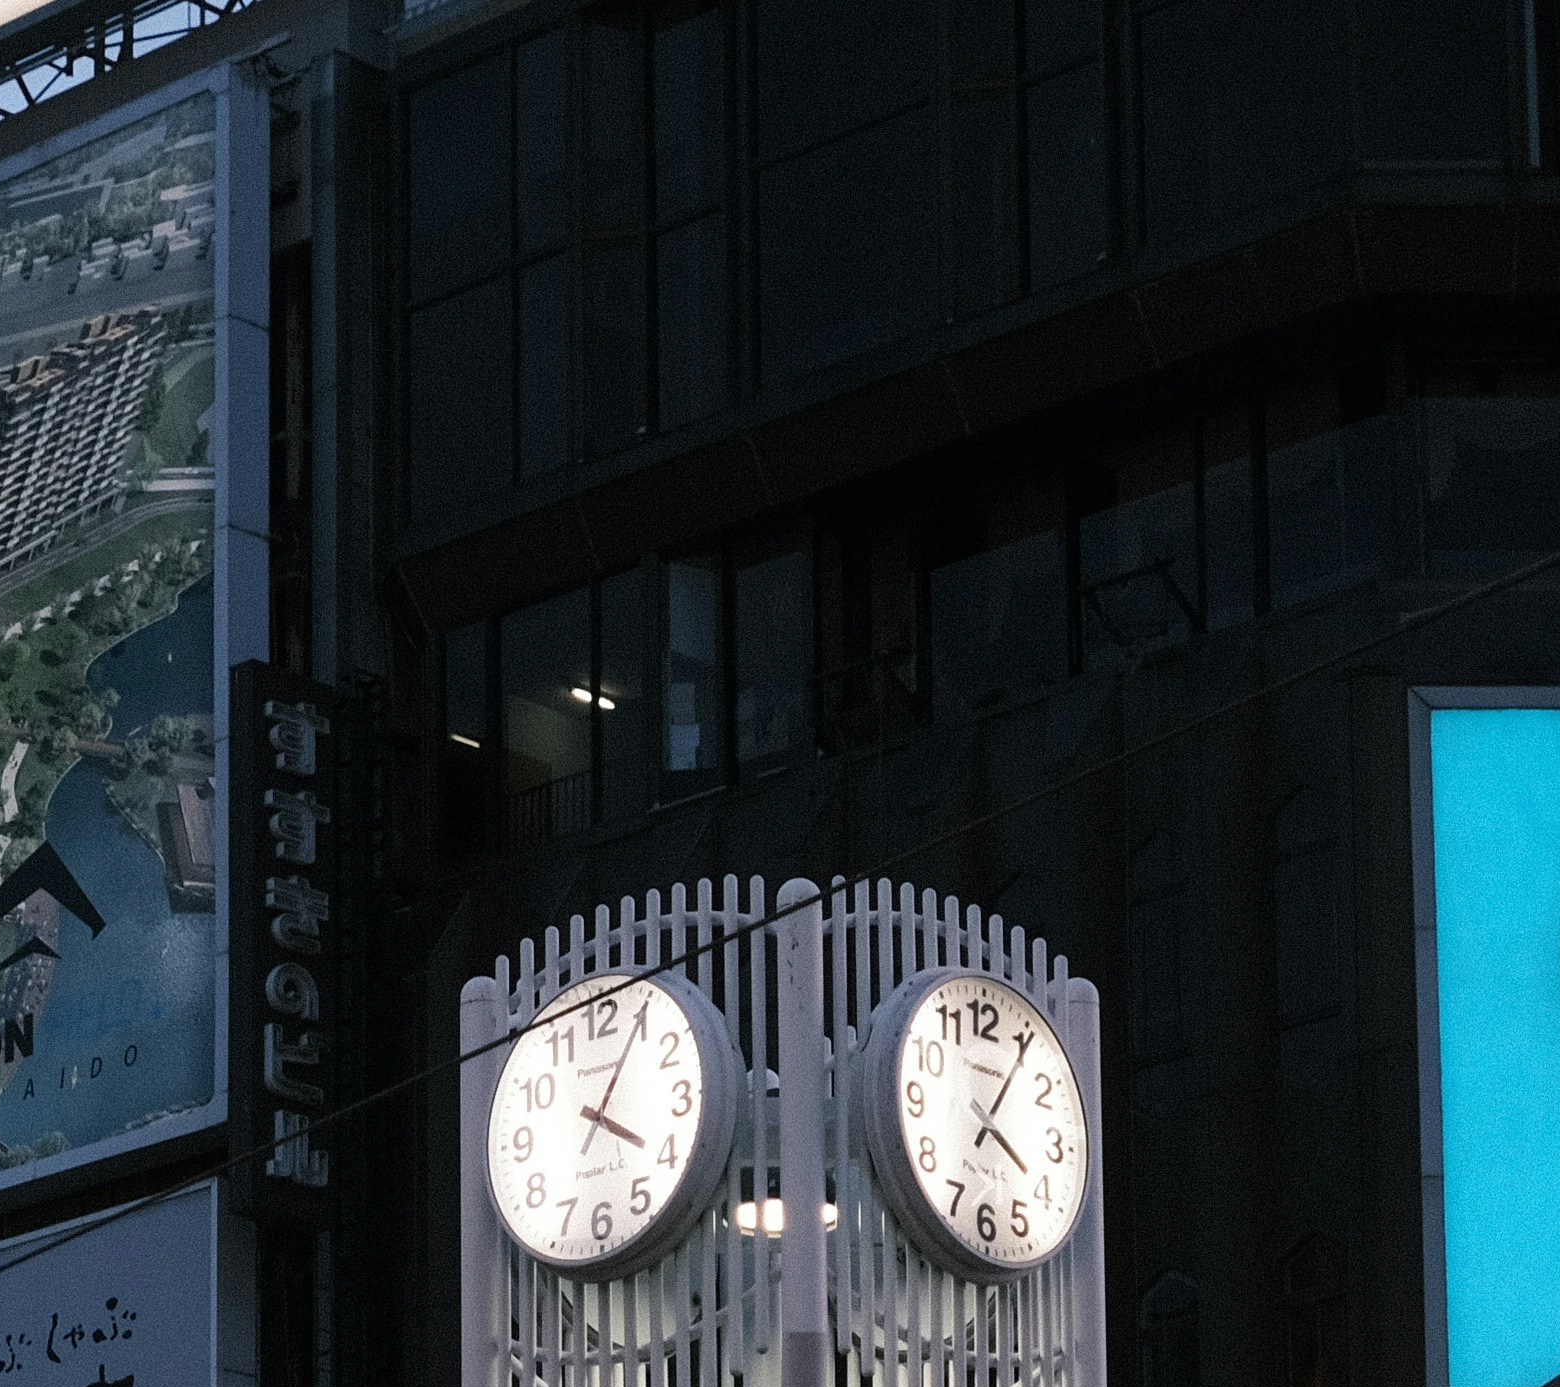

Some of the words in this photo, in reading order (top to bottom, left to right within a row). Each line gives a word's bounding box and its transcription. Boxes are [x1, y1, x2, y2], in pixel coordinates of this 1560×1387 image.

[582, 999, 619, 1040] 12
[634, 1000, 649, 1041] 1
[545, 1026, 575, 1066] 11
[660, 1033, 680, 1069] 2
[577, 1060, 619, 1079] Panason
[520, 1074, 555, 1112] 10
[671, 1079, 692, 1117] 3
[513, 1126, 533, 1162] 9
[658, 1135, 677, 1169] 4
[526, 1173, 546, 1208] 8
[630, 1176, 651, 1215] 5
[556, 1197, 578, 1236] 7
[591, 1202, 612, 1240] 6
